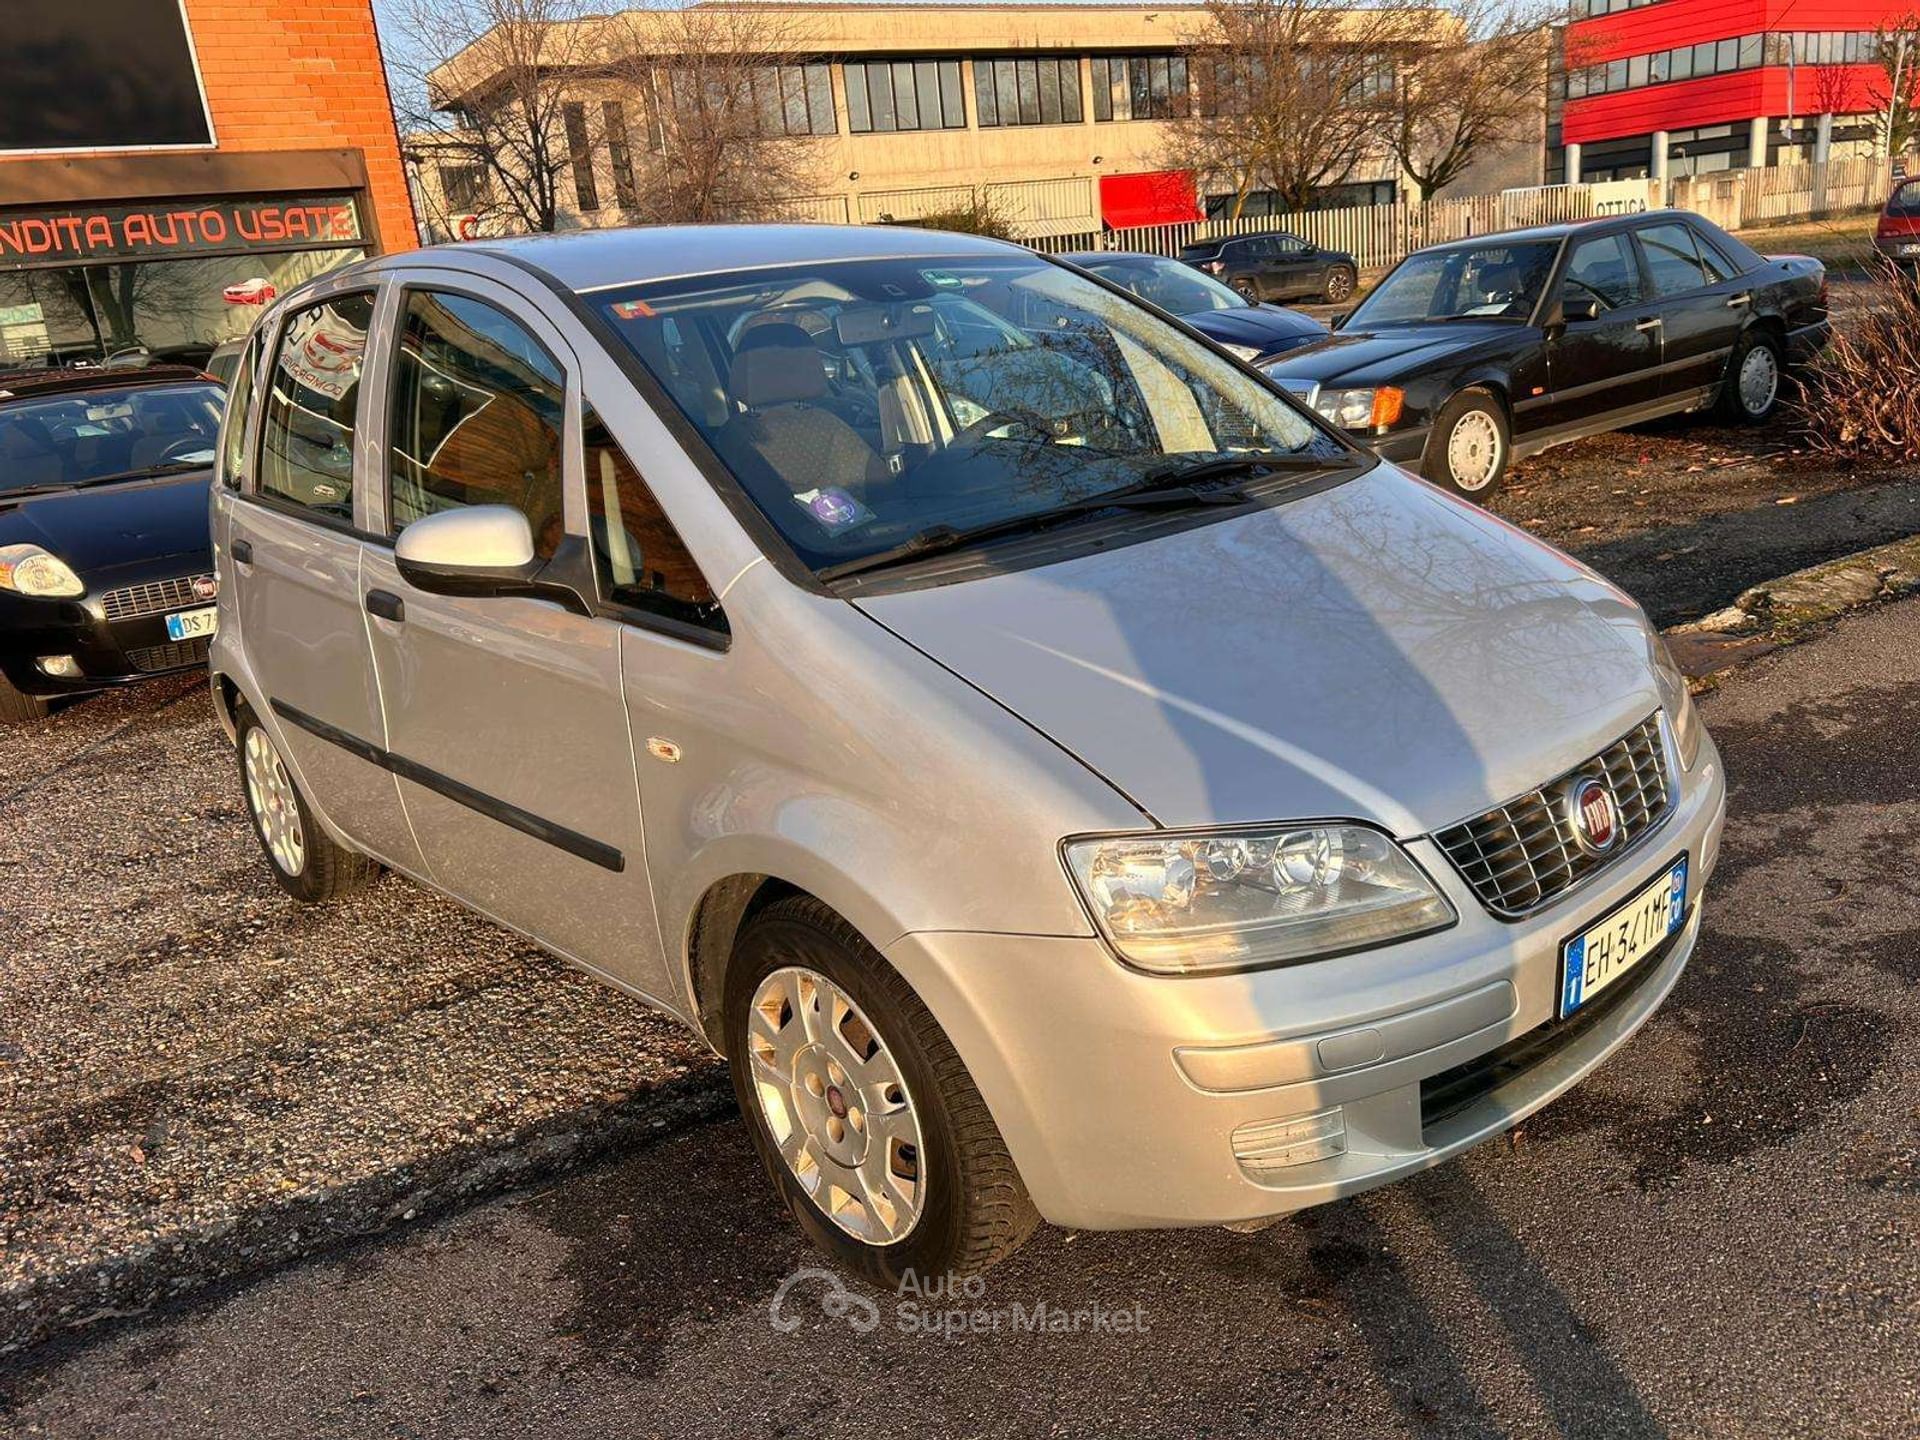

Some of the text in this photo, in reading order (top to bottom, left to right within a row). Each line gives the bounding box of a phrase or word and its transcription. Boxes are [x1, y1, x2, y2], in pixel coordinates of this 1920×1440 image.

[1596, 198, 1646, 216] OTTICA
[0, 204, 353, 254] NDITA AUTO USATE
[183, 615, 201, 633] DS
[1586, 932, 1612, 987] EH
